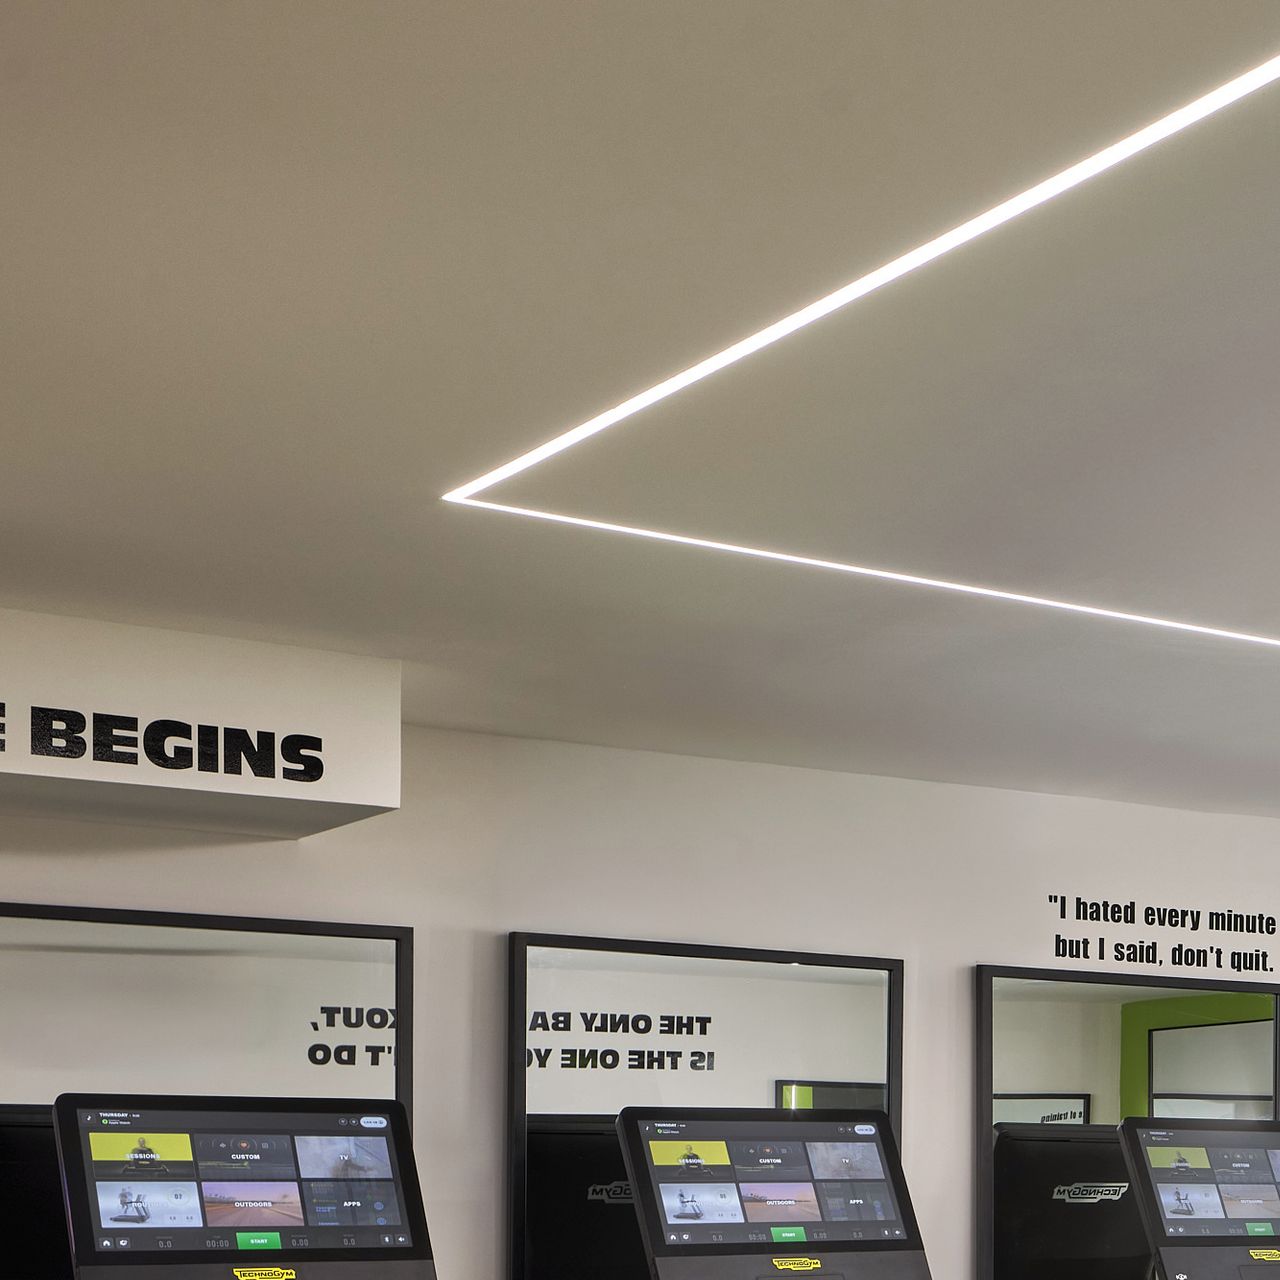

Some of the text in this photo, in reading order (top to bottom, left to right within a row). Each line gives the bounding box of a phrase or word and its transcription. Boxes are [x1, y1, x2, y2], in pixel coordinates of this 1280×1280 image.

[30, 705, 325, 783] BEGINS
[1048, 894, 1067, 919] "I
[1075, 896, 1136, 925] hated
[1143, 905, 1201, 932] every
[1208, 908, 1277, 936] minute
[1054, 934, 1090, 960] but
[1098, 936, 1106, 961] I
[1113, 939, 1164, 967] said,
[1170, 943, 1224, 969] don't
[1230, 948, 1275, 973] quit.
[231, 1153, 261, 1161] CUSTOM
[343, 1200, 362, 1208] APPS
